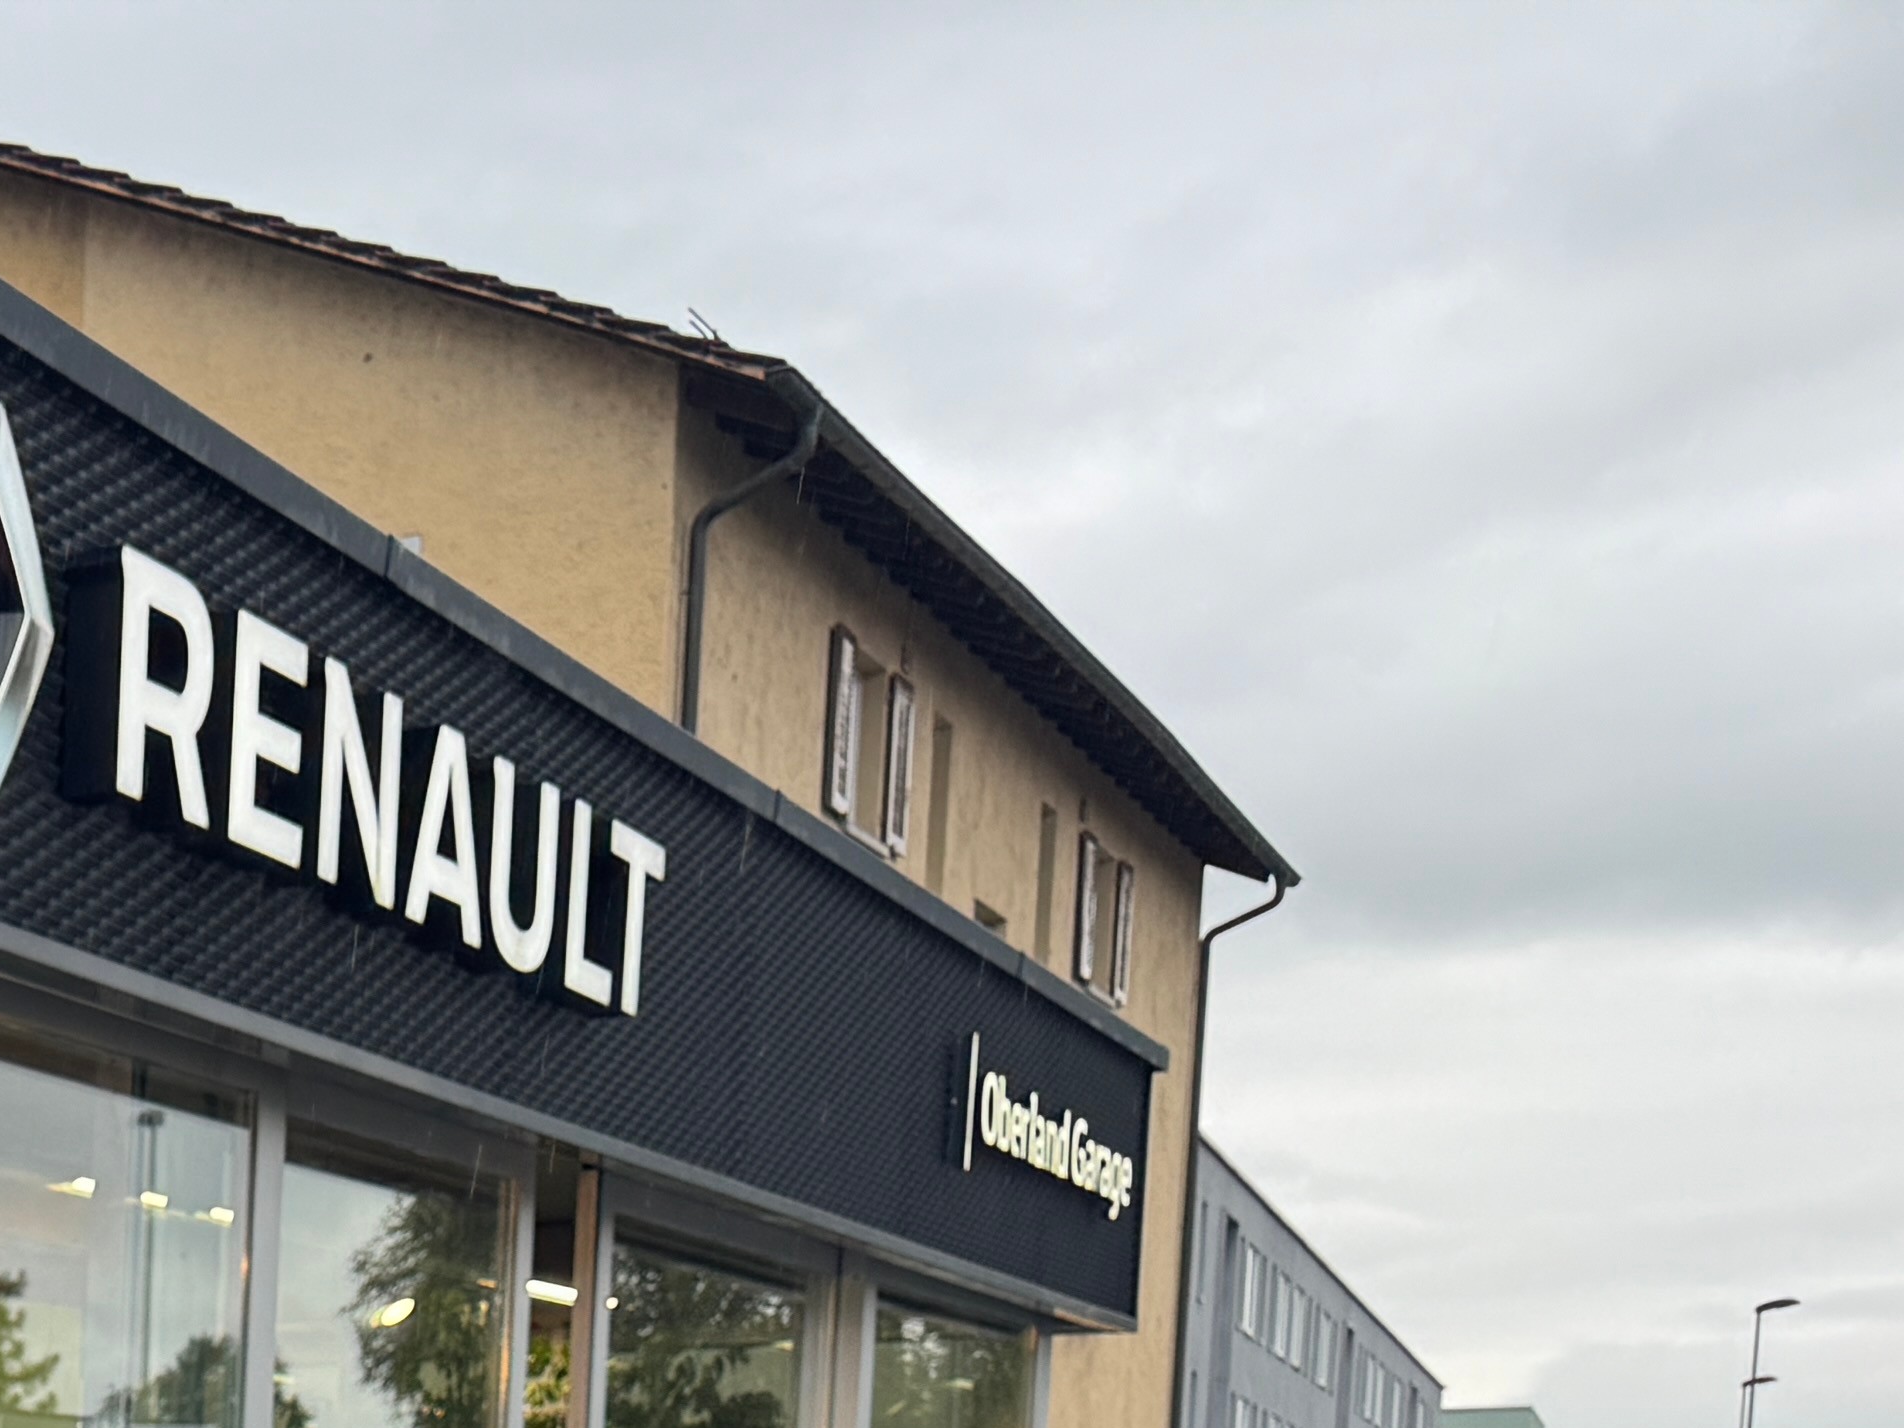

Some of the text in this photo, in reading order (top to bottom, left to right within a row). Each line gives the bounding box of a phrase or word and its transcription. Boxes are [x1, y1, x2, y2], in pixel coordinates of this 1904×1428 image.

[116, 543, 666, 1017] RENAULT
[980, 1071, 1134, 1221] Oberland Garage
